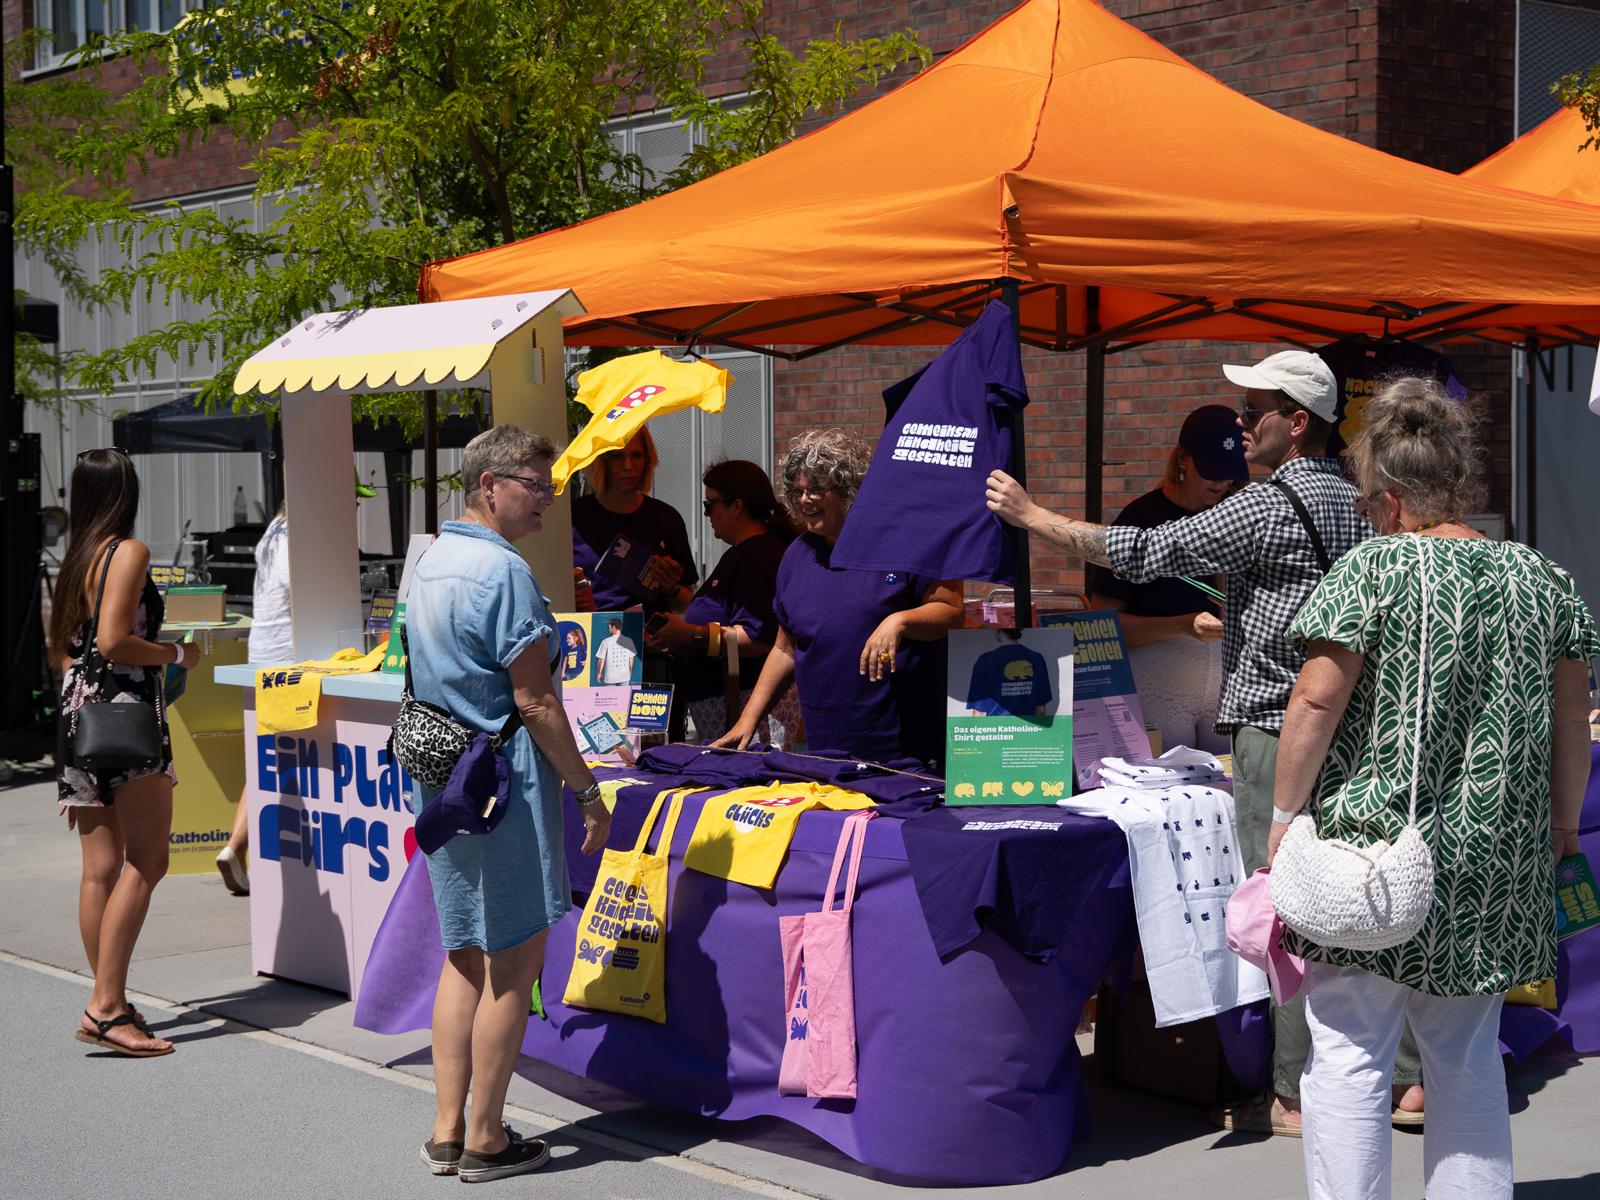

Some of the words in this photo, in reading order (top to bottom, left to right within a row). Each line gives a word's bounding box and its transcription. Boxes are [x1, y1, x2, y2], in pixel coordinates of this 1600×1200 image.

[1048, 618, 1117, 641] enden
[970, 726, 997, 734] eigene
[998, 725, 1043, 733] Katholino-
[975, 734, 1014, 742] gestalten
[257, 734, 320, 799] Ein
[169, 829, 233, 844] Katholin
